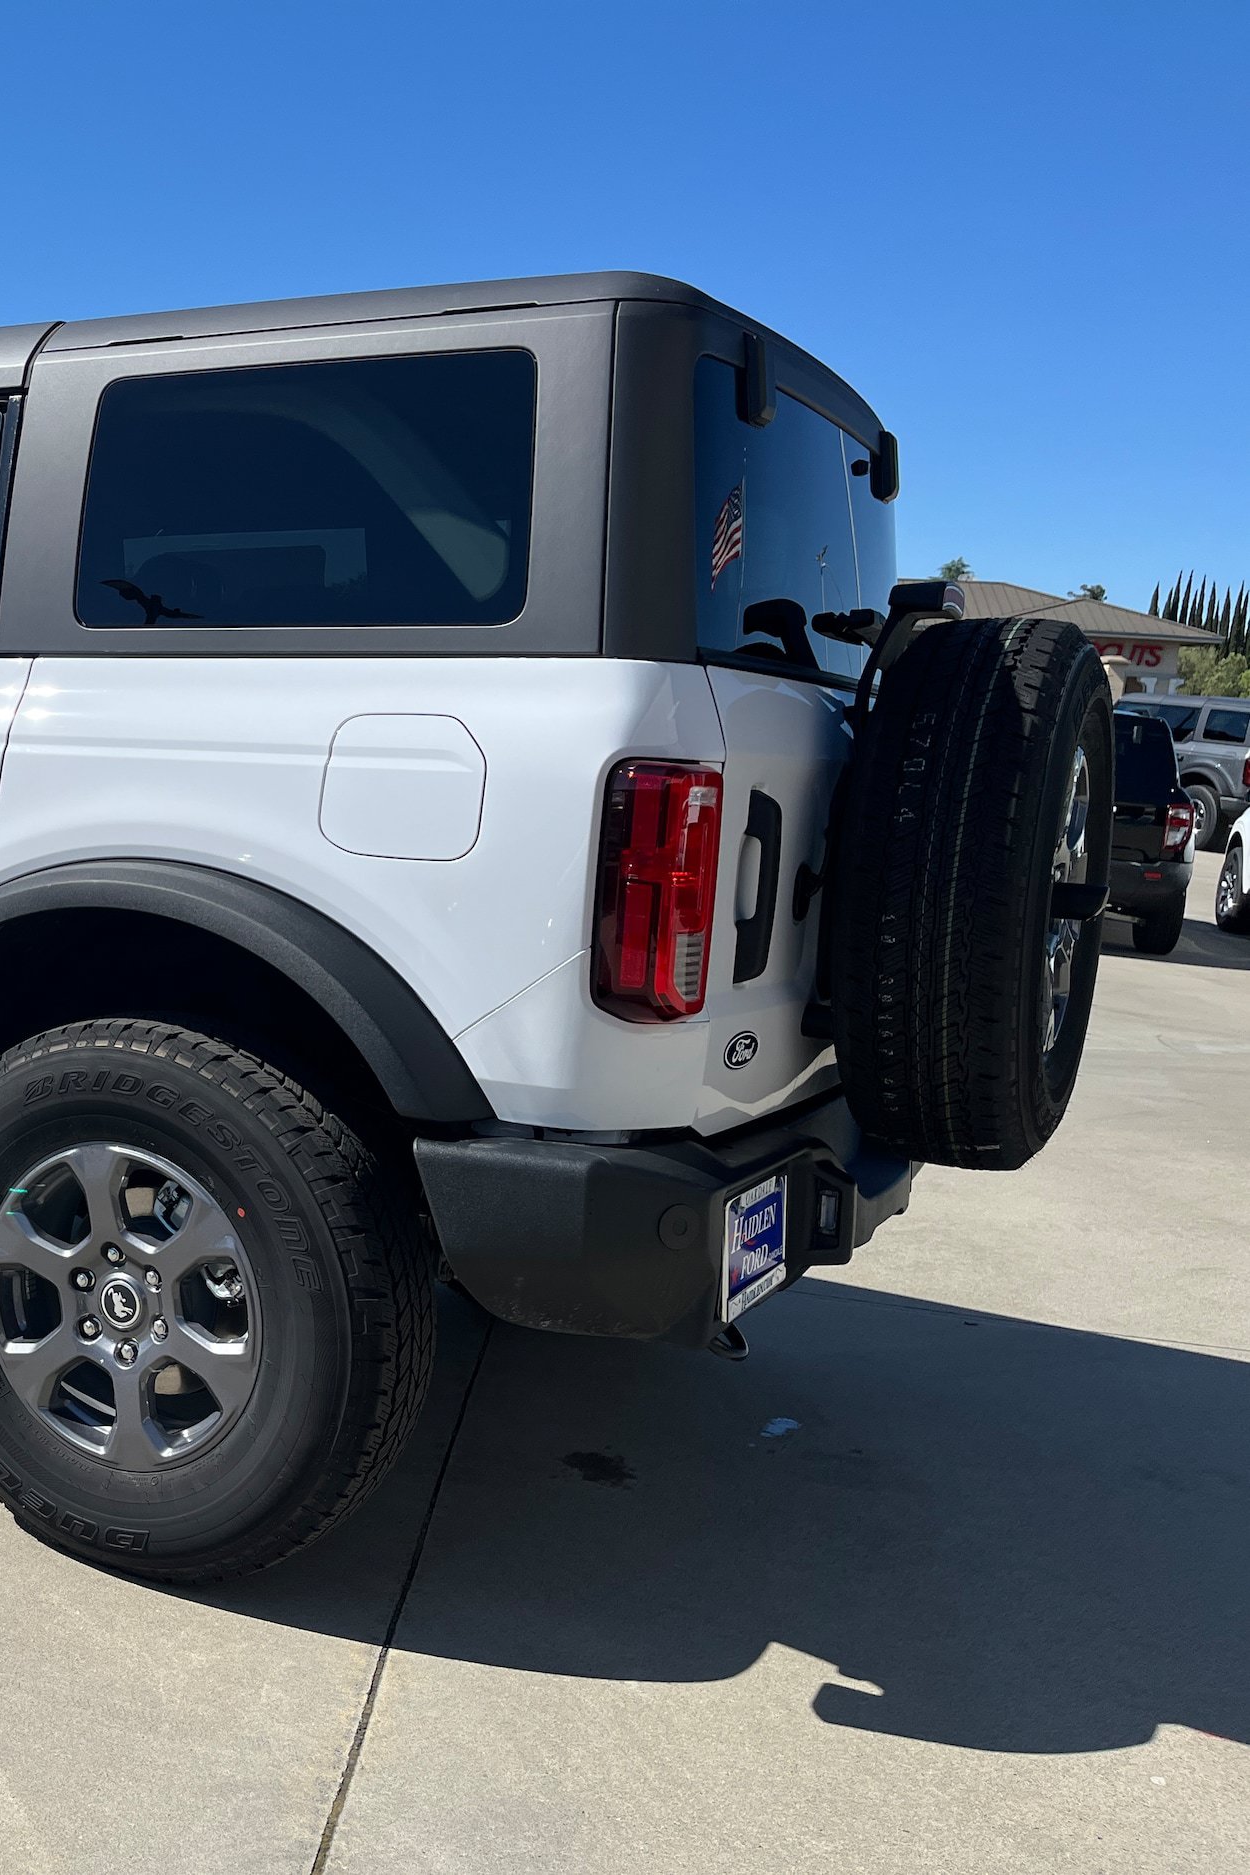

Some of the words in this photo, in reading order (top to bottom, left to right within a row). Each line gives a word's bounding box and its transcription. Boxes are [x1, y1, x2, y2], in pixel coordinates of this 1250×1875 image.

[731, 1038, 754, 1063] Ford
[23, 1069, 324, 1293] BRIDGESTONE
[740, 1243, 769, 1281] FORD
